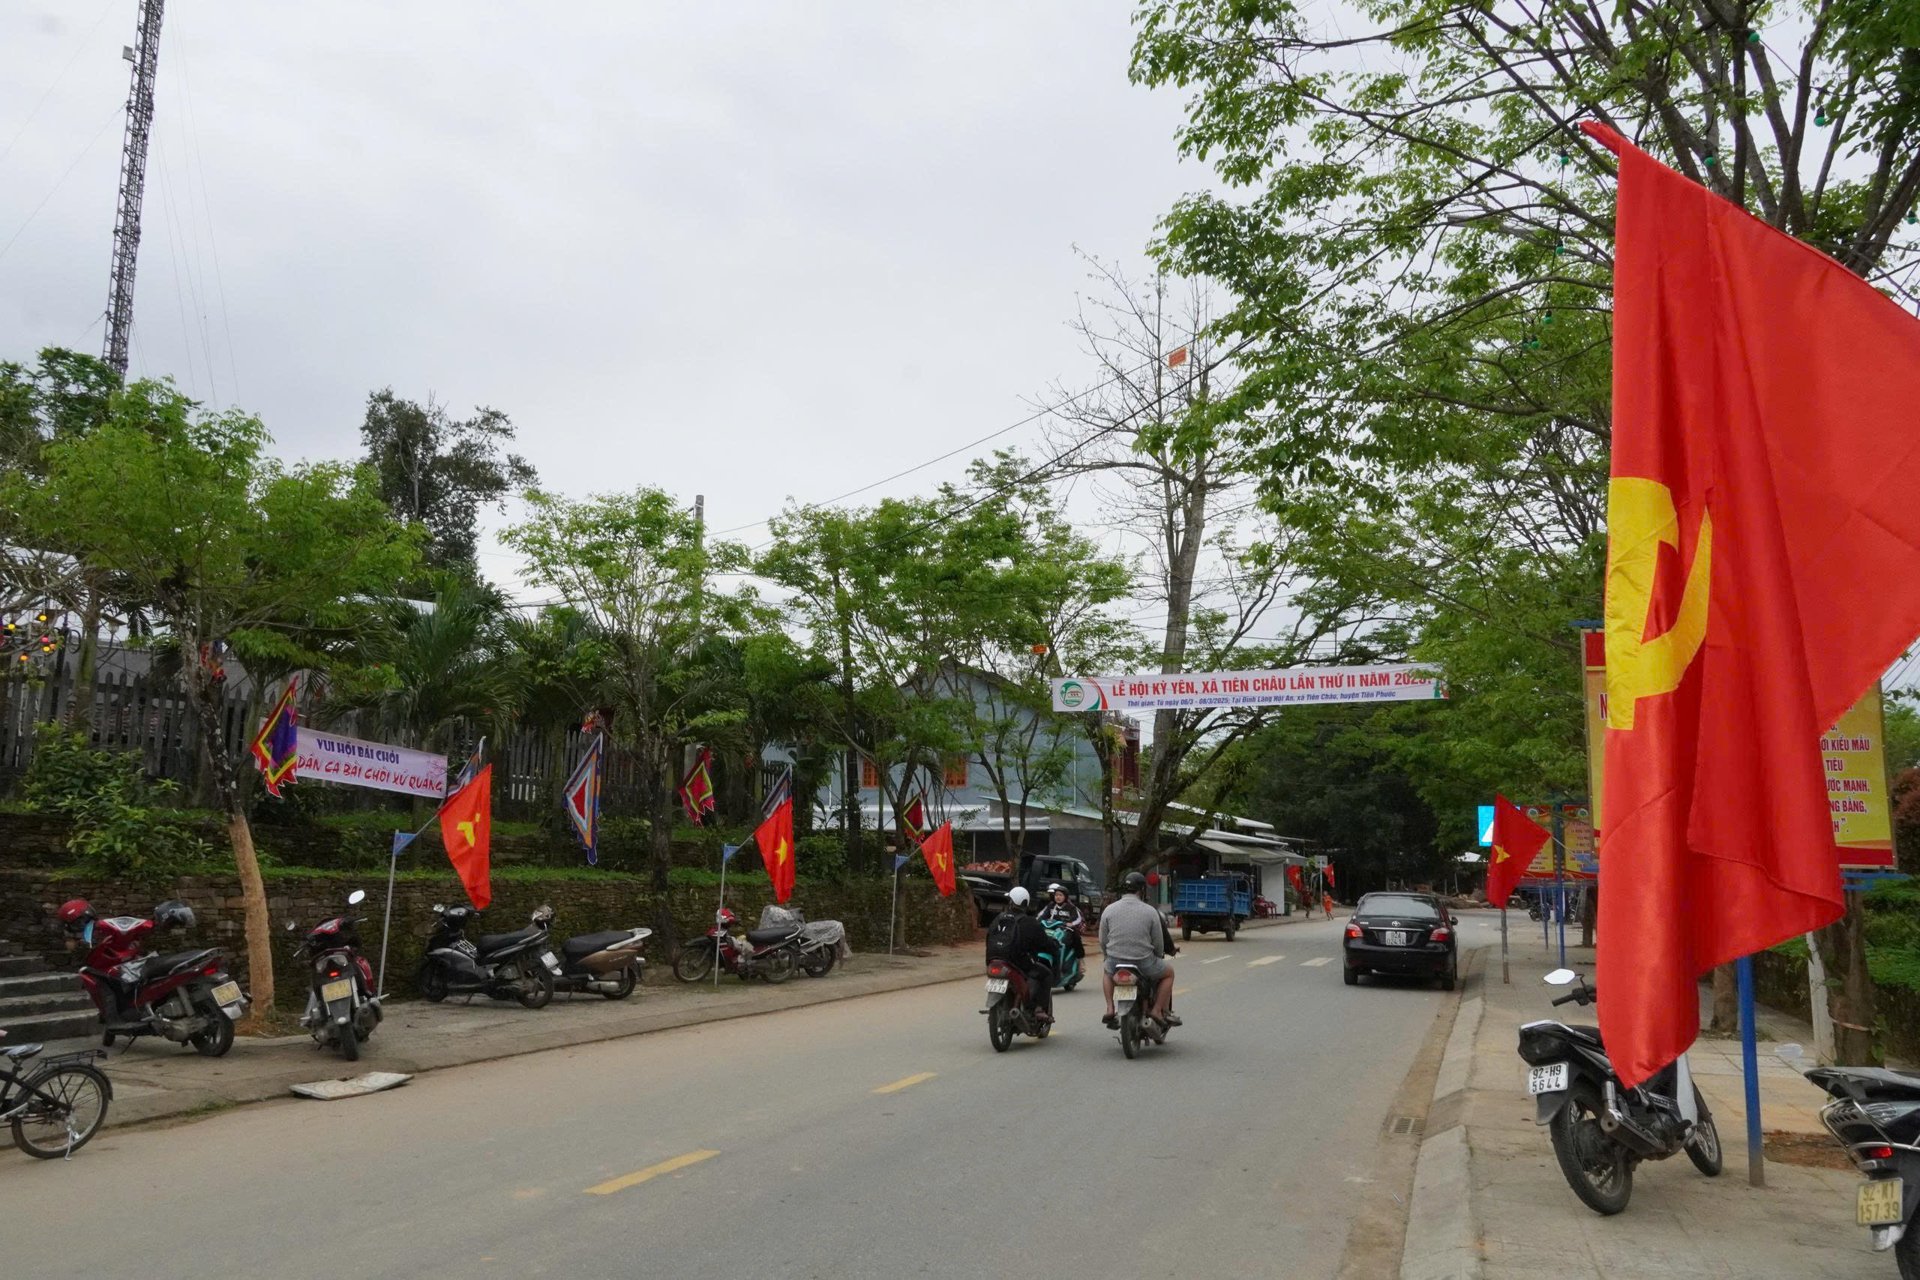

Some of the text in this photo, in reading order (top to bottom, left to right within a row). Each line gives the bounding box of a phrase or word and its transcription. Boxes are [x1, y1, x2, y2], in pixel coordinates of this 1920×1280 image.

[1129, 680, 1149, 698] HỘI
[1202, 678, 1218, 693] XÃ
[1222, 677, 1249, 692] TIÊN
[1253, 675, 1286, 691] CHÂU
[1290, 672, 1315, 690] LẦN
[1318, 673, 1344, 689] THỨ
[1347, 675, 1355, 688] II
[1359, 672, 1390, 687] NĂM
[317, 739, 335, 752] VUI
[337, 741, 356, 757] HỘI
[1831, 735, 1850, 751] KIỂU
[1851, 735, 1870, 751] MẪU
[297, 753, 320, 771] DÂN
[325, 761, 340, 774] CA
[343, 760, 362, 777] BÀI
[1826, 757, 1843, 771] TIÊU
[1532, 1064, 1562, 1080] 92-H9
[1532, 1077, 1560, 1092] 5644
